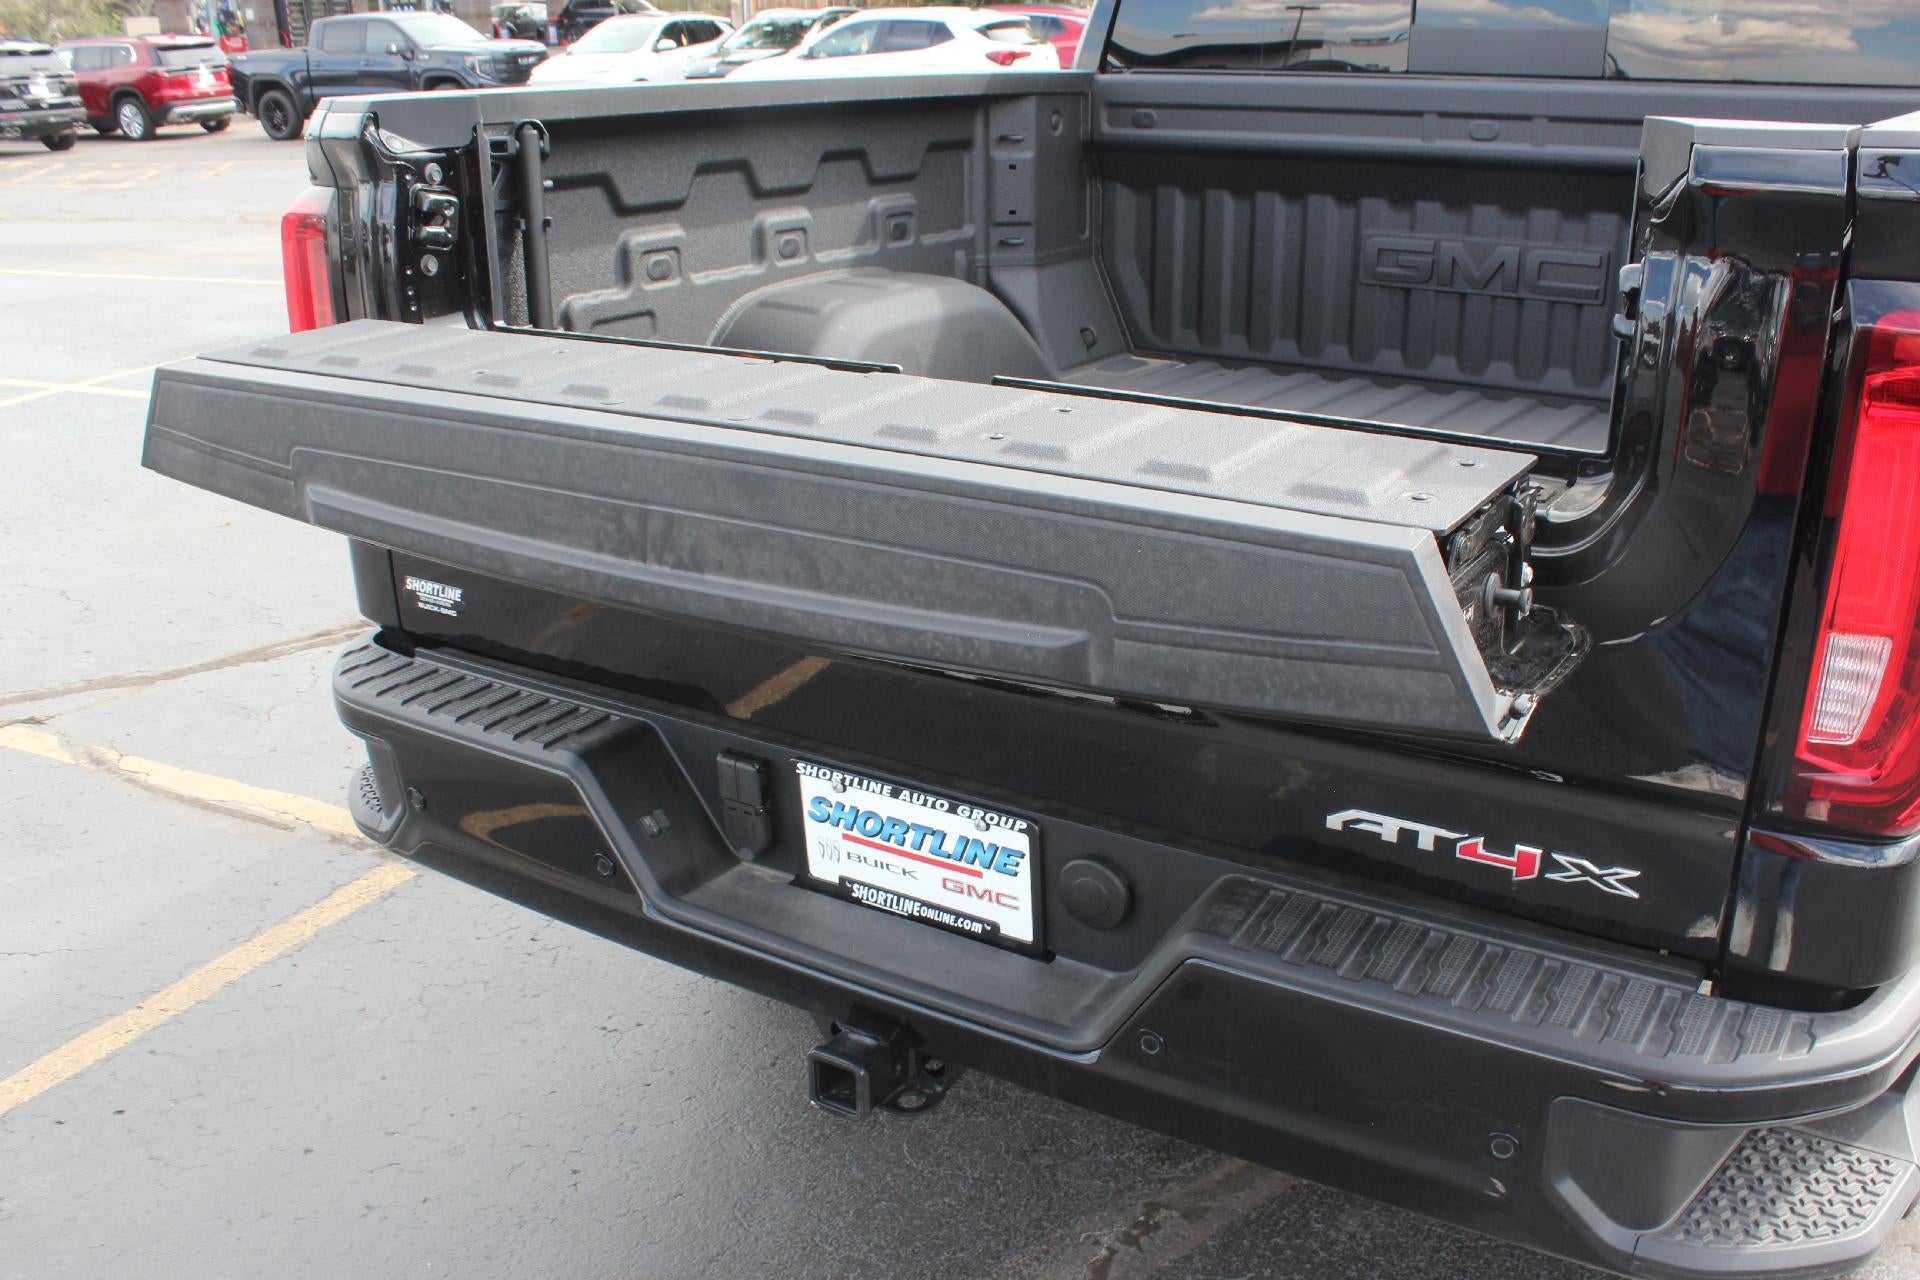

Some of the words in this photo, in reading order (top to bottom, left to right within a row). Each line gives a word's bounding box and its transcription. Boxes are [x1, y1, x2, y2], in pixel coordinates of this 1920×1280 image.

[1364, 236, 1603, 300] GMC
[405, 577, 463, 602] SHORTLINE
[796, 762, 893, 797] SHORTLINE
[899, 790, 950, 812] AUTO
[956, 804, 1028, 832] GROUP
[807, 796, 1026, 878] SHORTLINE
[847, 851, 919, 880] BUICK
[942, 878, 1020, 911] GMC
